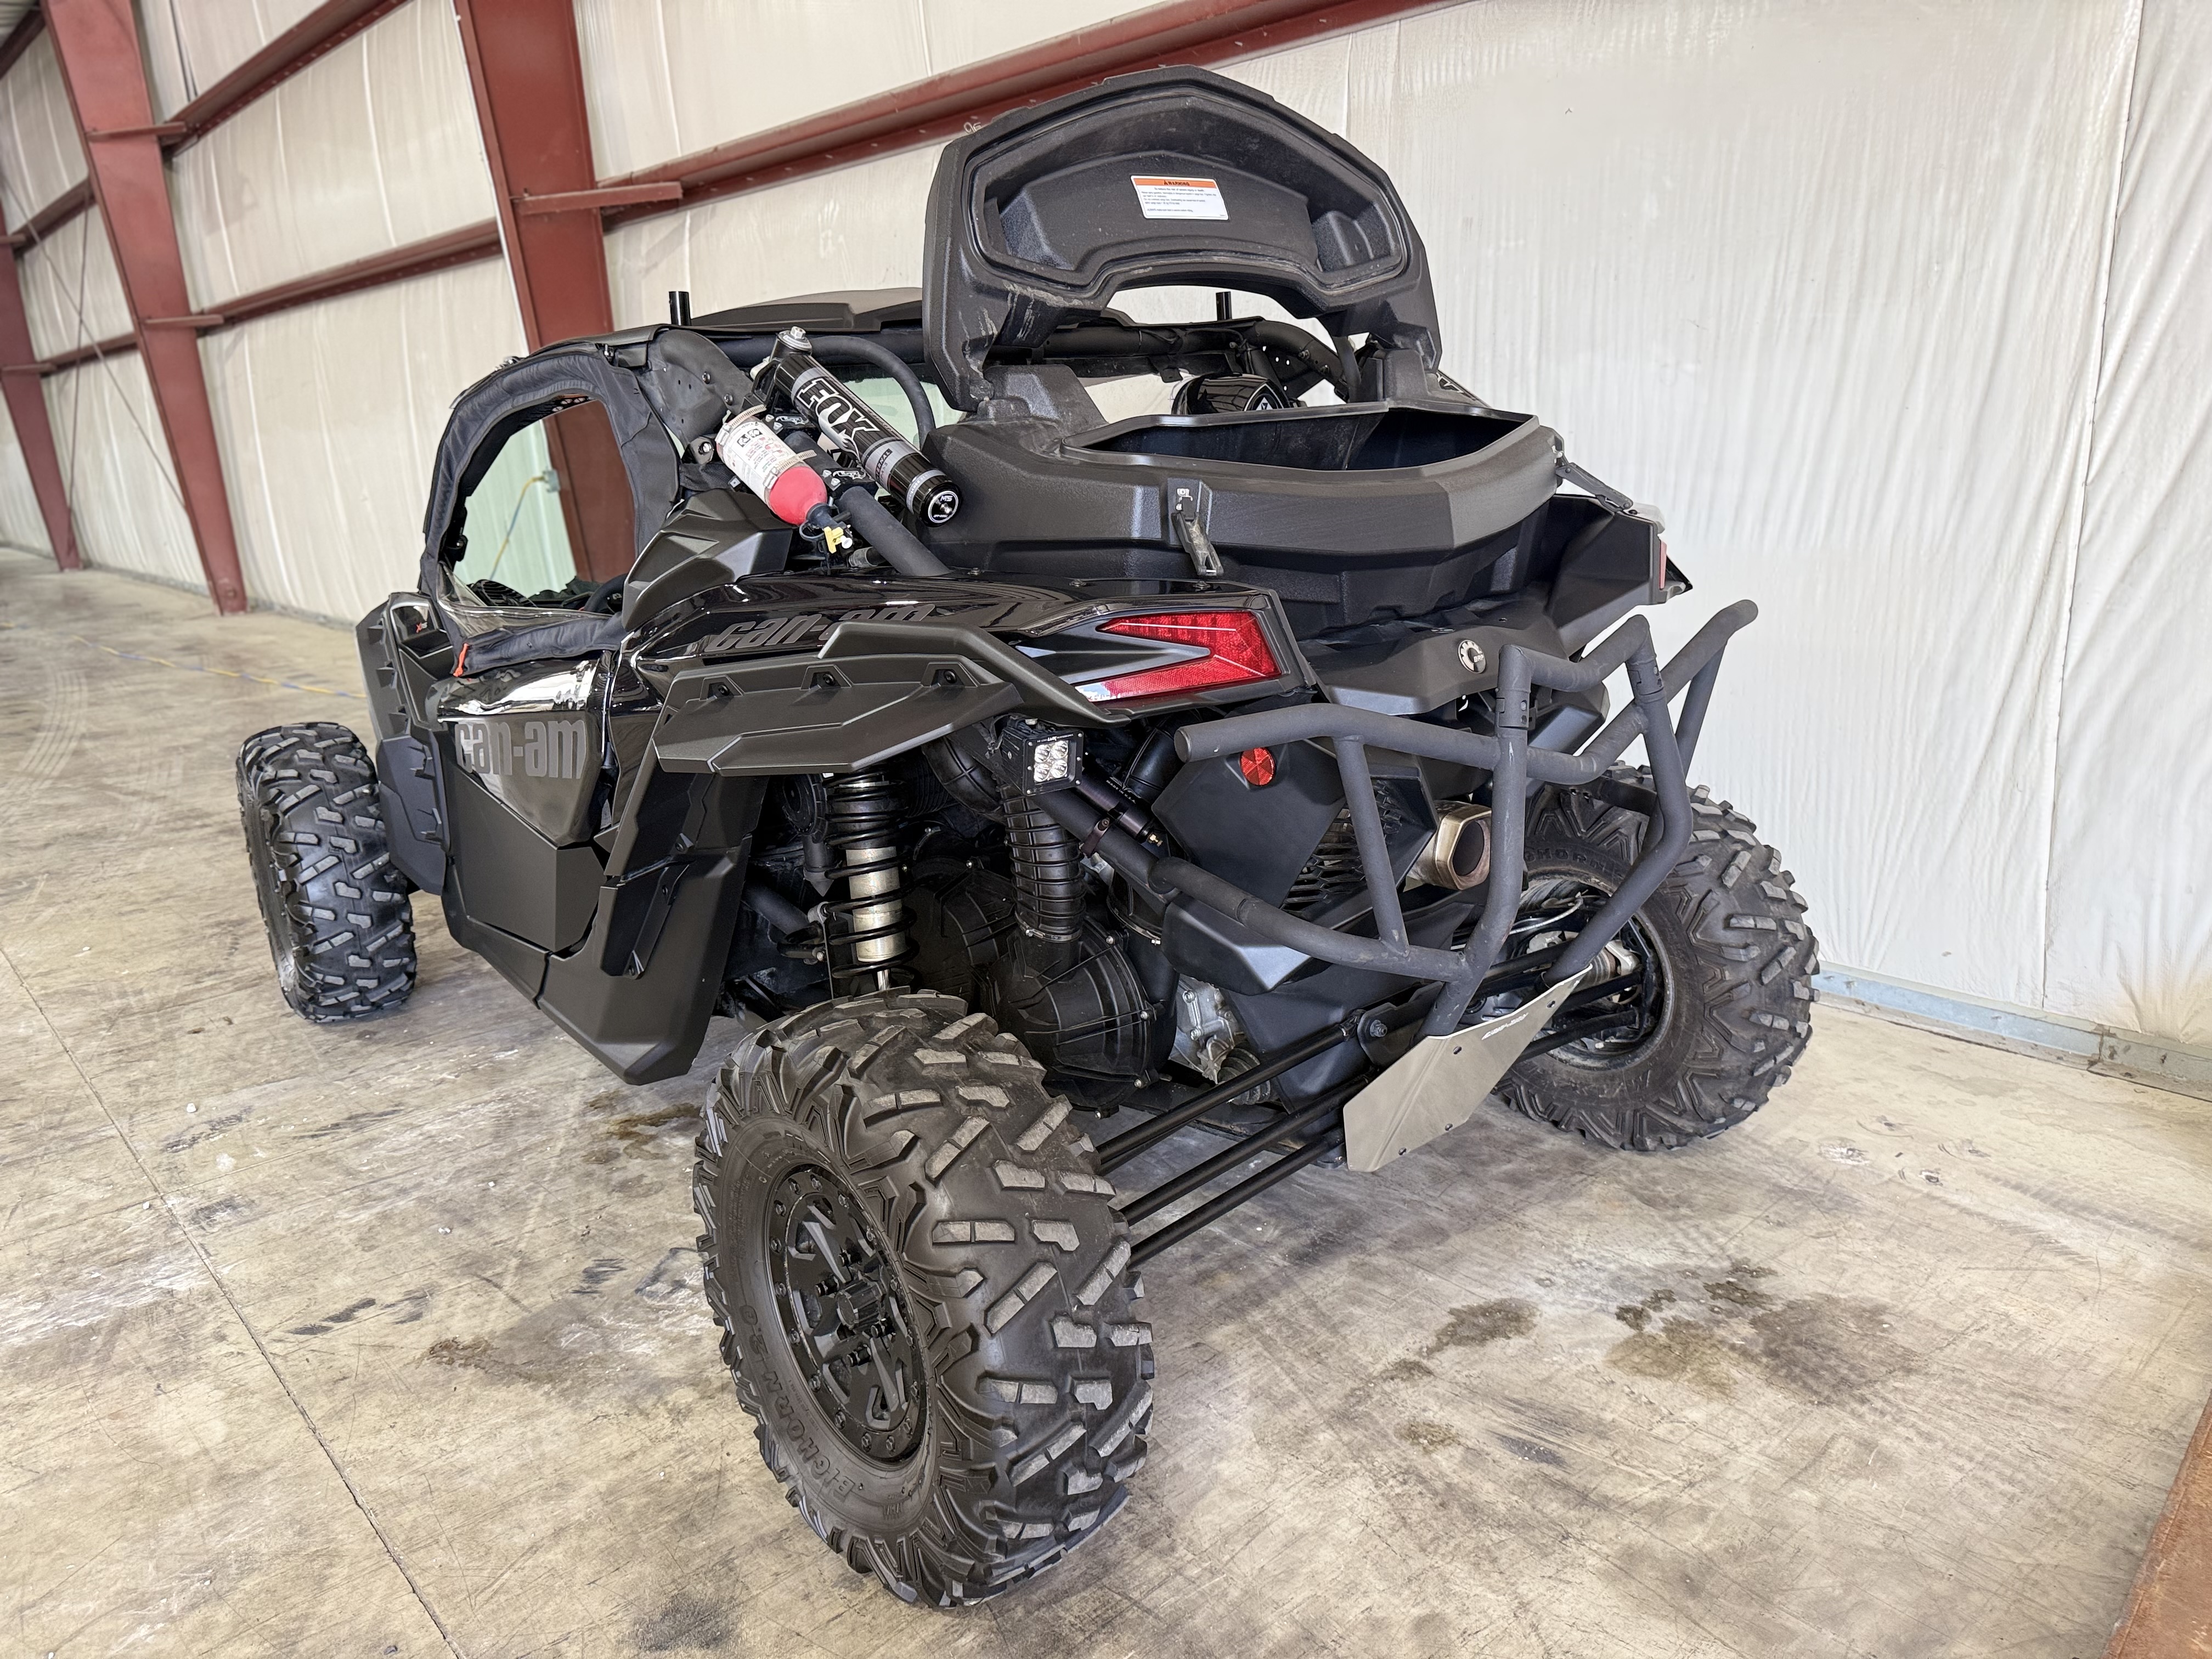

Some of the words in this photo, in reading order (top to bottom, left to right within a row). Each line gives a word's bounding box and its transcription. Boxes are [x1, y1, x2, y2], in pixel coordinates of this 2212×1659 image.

[797, 377, 881, 441] FOX
[1474, 654, 1484, 663] BRP
[1106, 780, 1119, 790] MADE
[763, 1370, 856, 1502] BIGHORN
